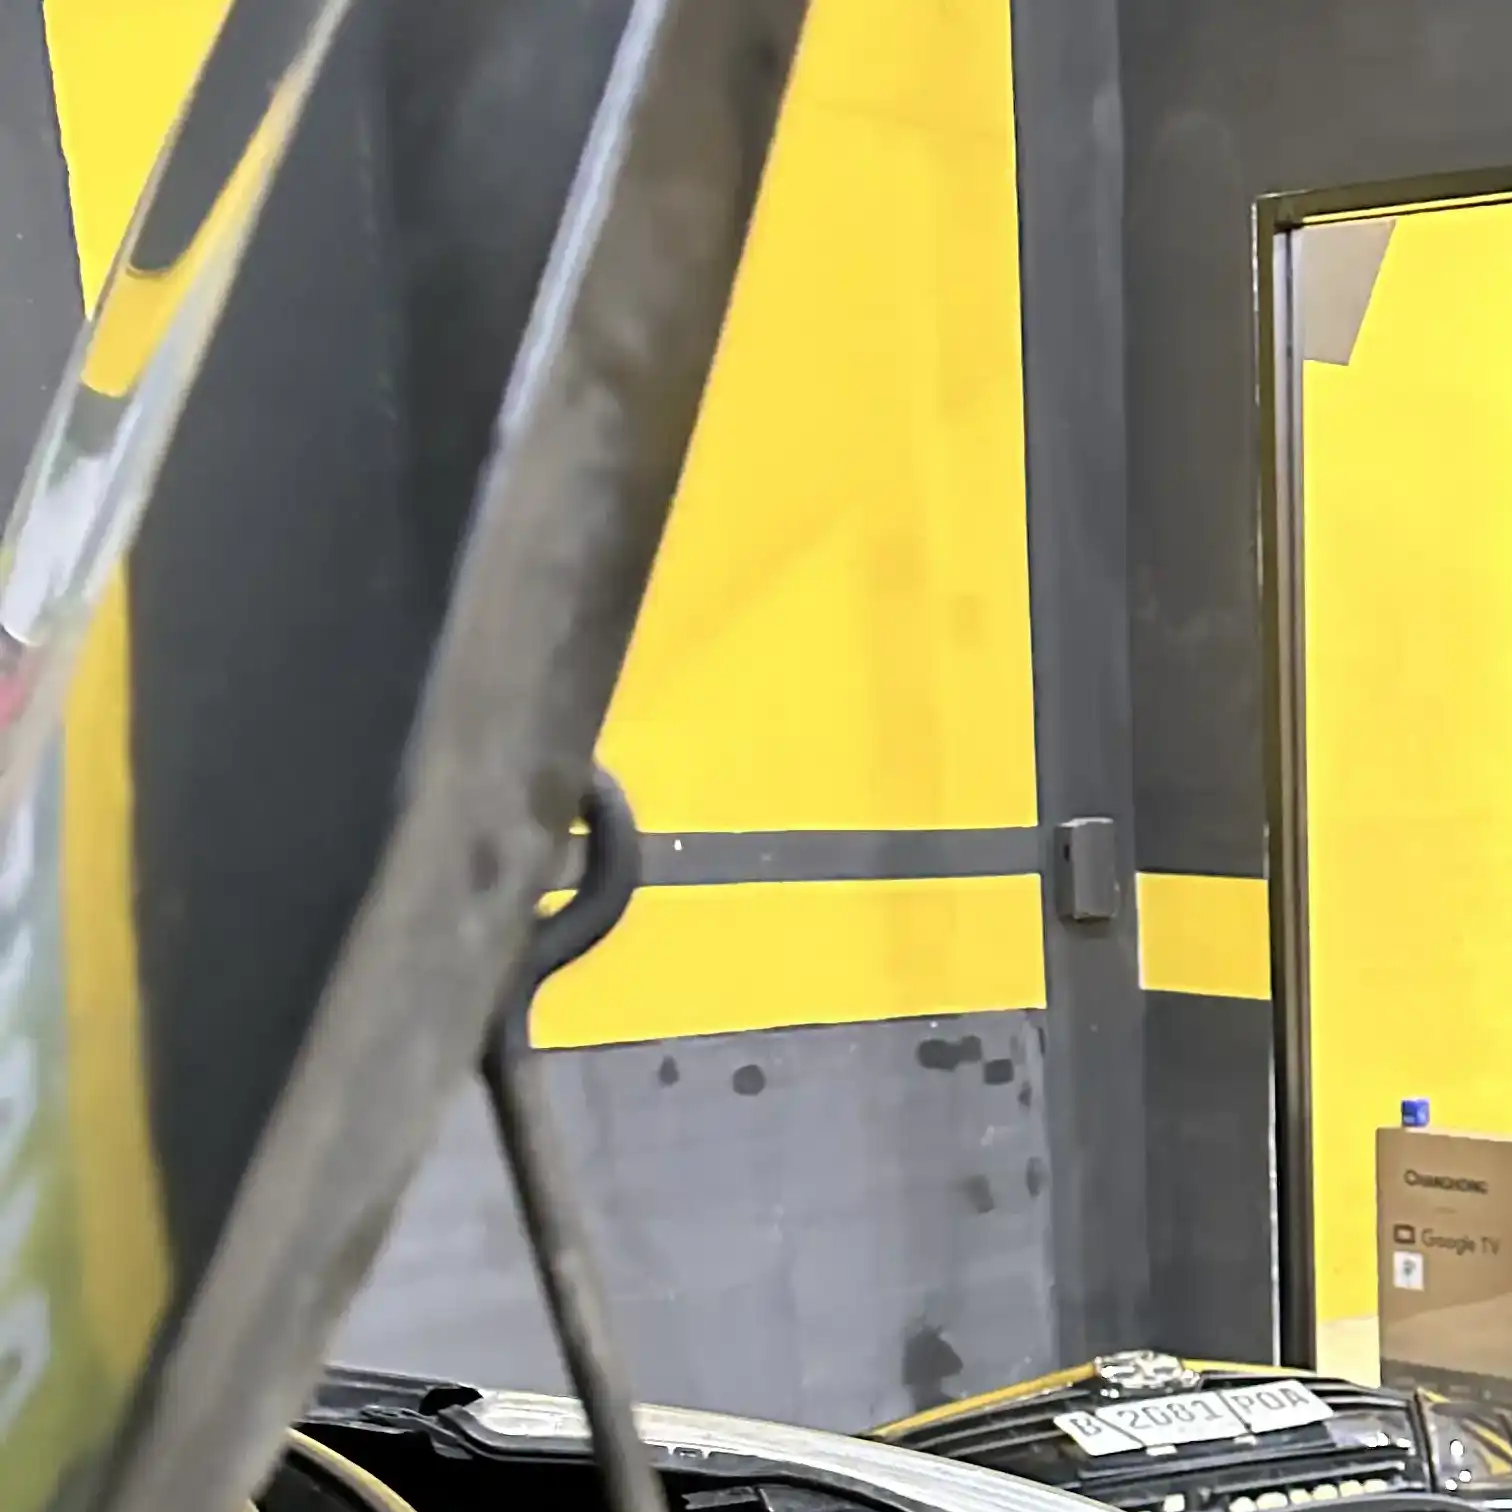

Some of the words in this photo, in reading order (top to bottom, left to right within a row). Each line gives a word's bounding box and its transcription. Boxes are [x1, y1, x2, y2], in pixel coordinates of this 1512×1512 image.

[1421, 1227, 1476, 1257] Google
[1480, 1236, 1502, 1256] TV
[1069, 1417, 1104, 1439] B
